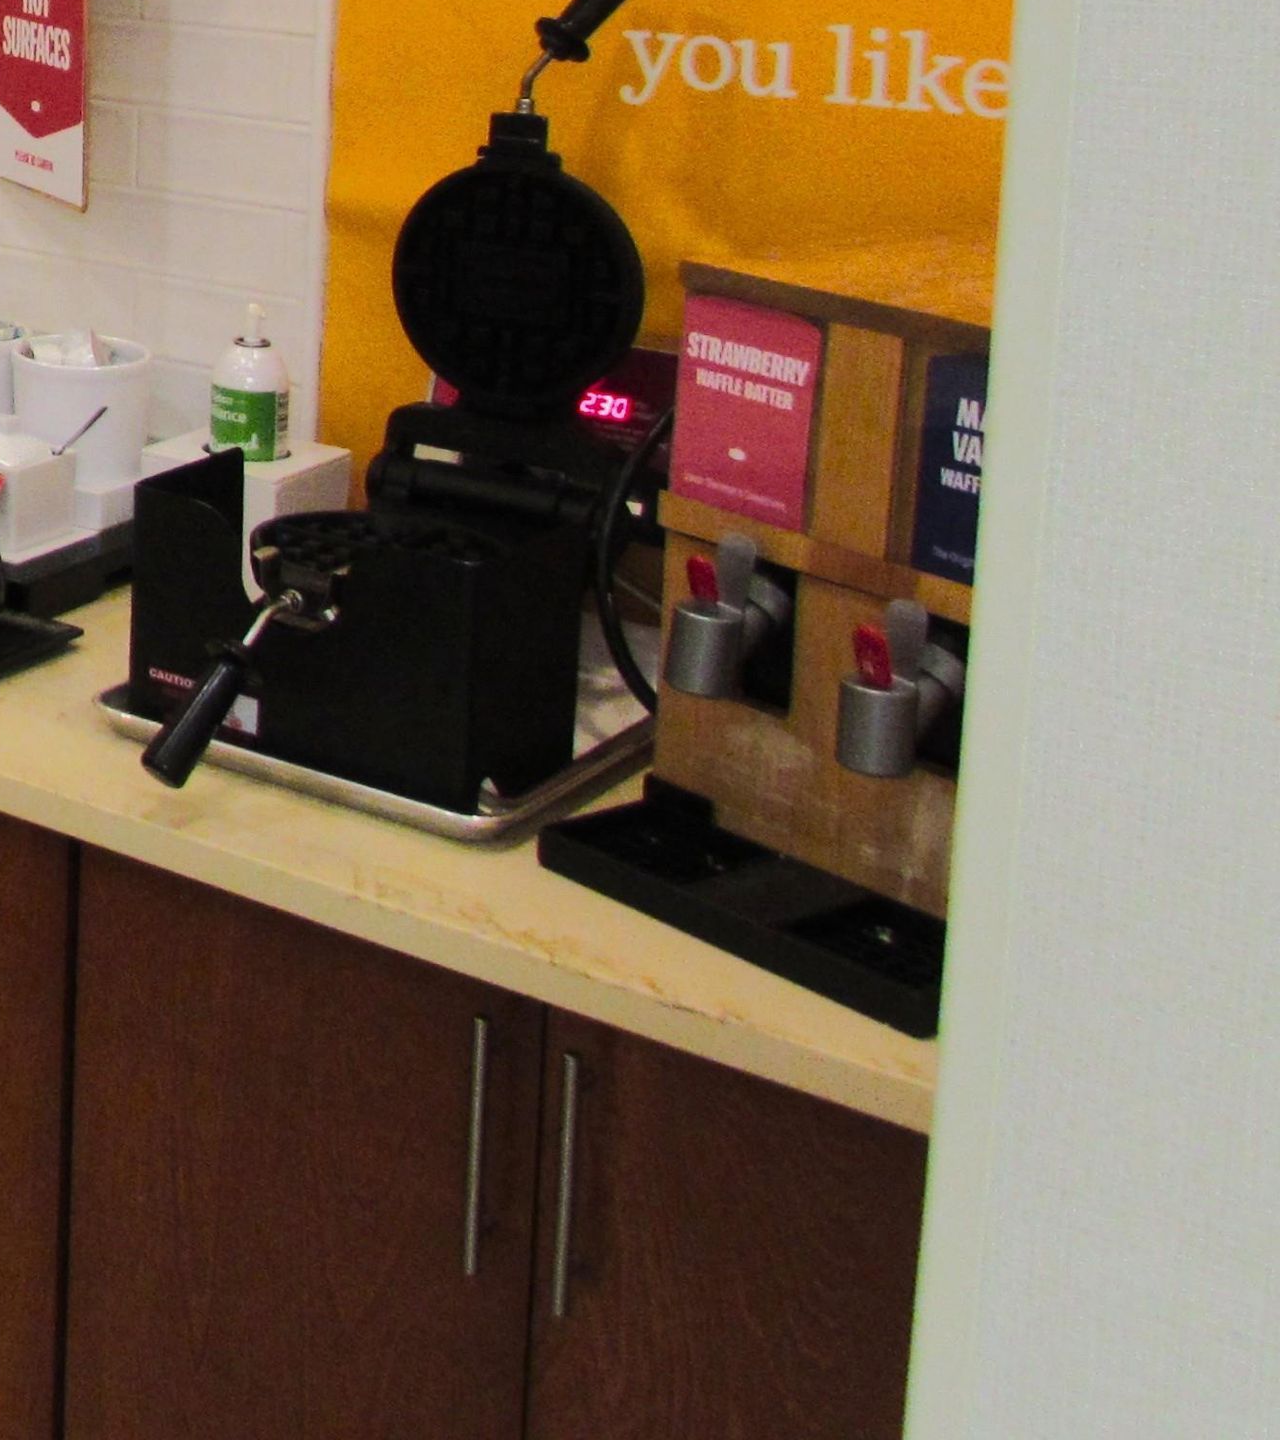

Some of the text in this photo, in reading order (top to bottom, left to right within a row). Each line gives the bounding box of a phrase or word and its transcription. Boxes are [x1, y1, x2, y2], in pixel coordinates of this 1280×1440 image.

[1, 15, 72, 72] SURFACES
[619, 23, 1012, 120] you like
[686, 331, 811, 387] STRAWBERRY
[955, 397, 987, 430] M
[148, 666, 197, 690] CAUTIO
